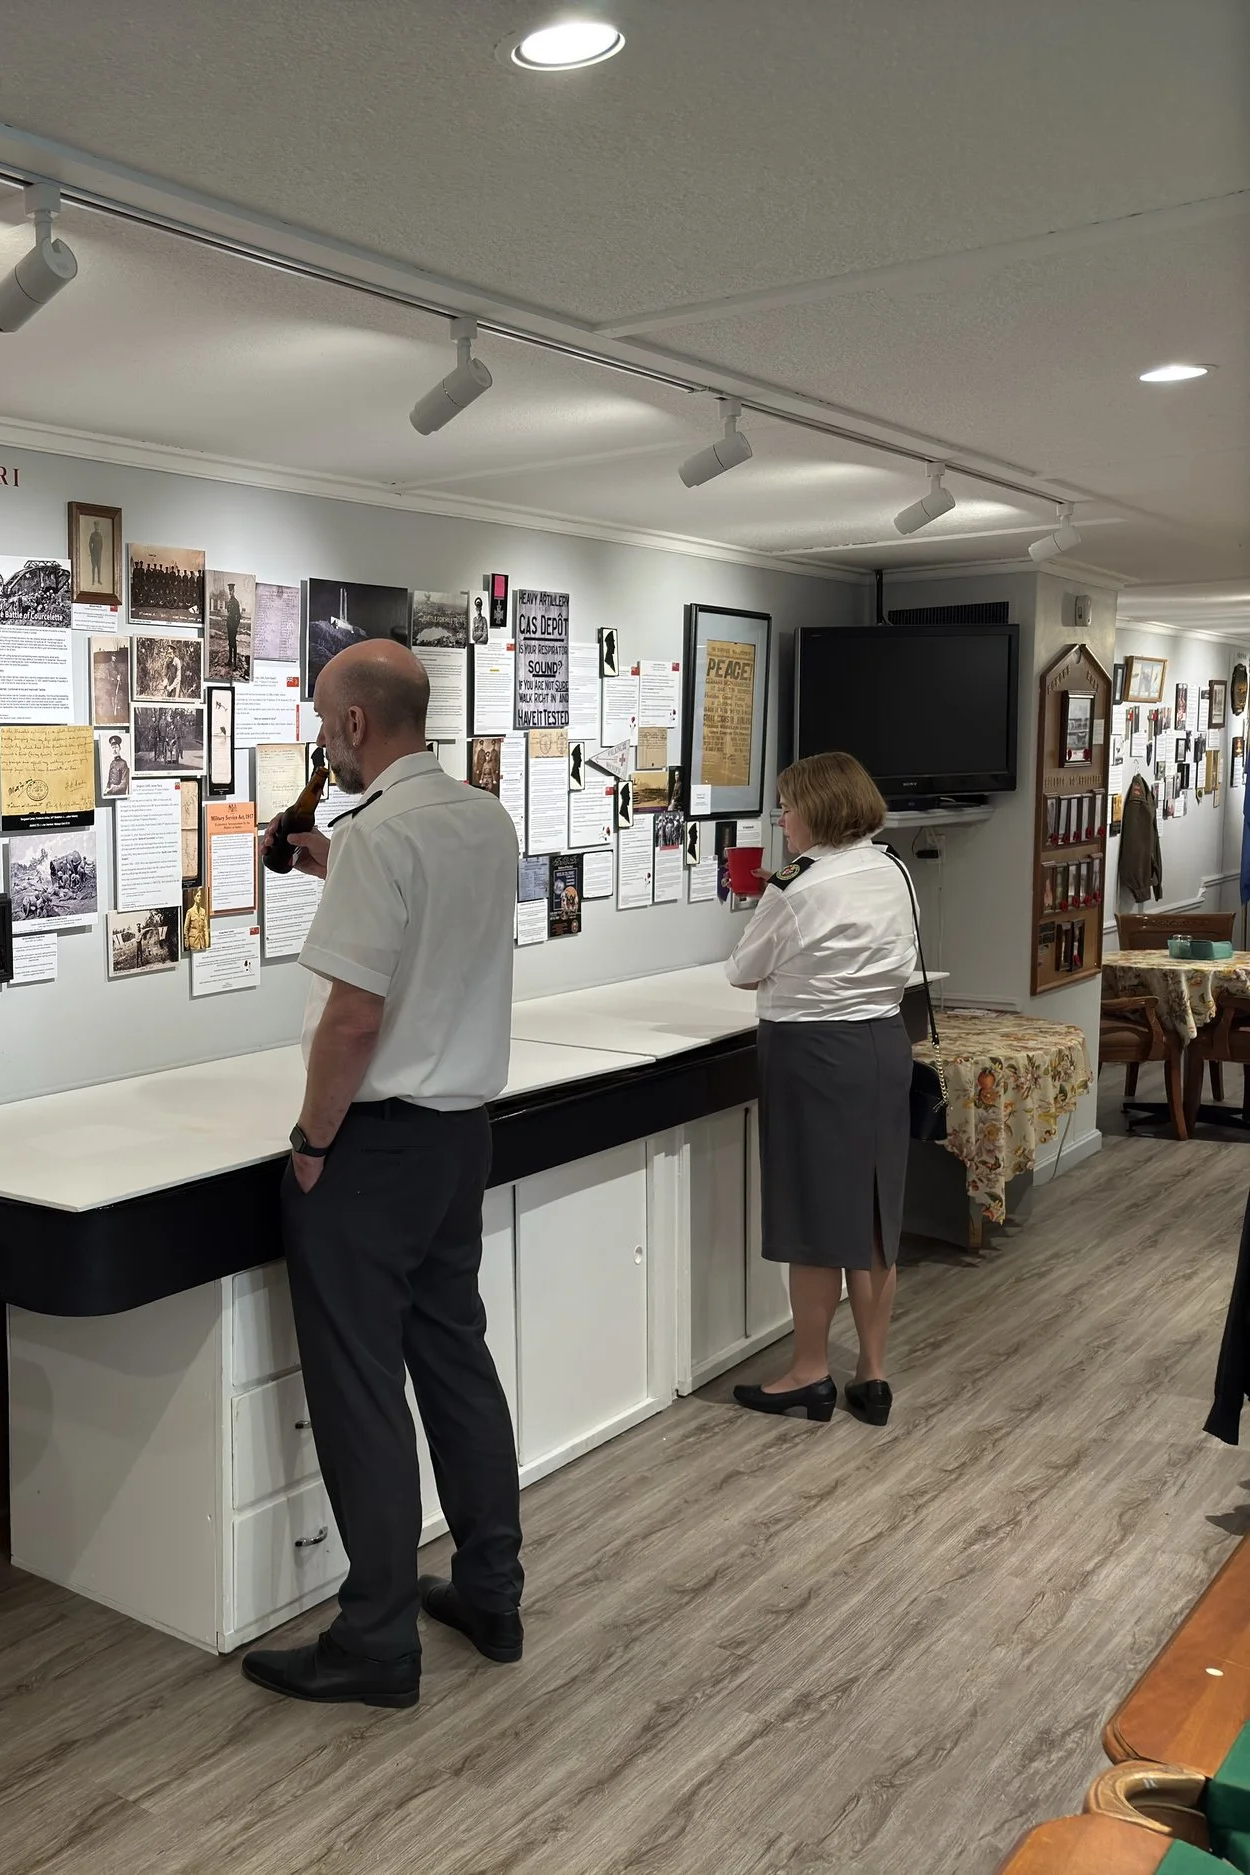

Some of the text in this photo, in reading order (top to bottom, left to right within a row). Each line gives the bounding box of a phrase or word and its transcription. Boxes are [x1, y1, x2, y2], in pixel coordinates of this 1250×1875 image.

[13, 468, 20, 487] I
[519, 592, 569, 607] HEAVY ARTILLERY
[5, 611, 23, 619] Battle
[30, 612, 63, 621] Courcelette
[519, 614, 537, 635] GAS
[537, 643, 568, 656] RESPIRATOR
[528, 660, 563, 675] SOUND?
[523, 680, 534, 690] YOU
[534, 680, 544, 690] ARE
[544, 680, 554, 690] NOT
[518, 709, 536, 726] HAVE
[543, 709, 569, 726] TESTED
